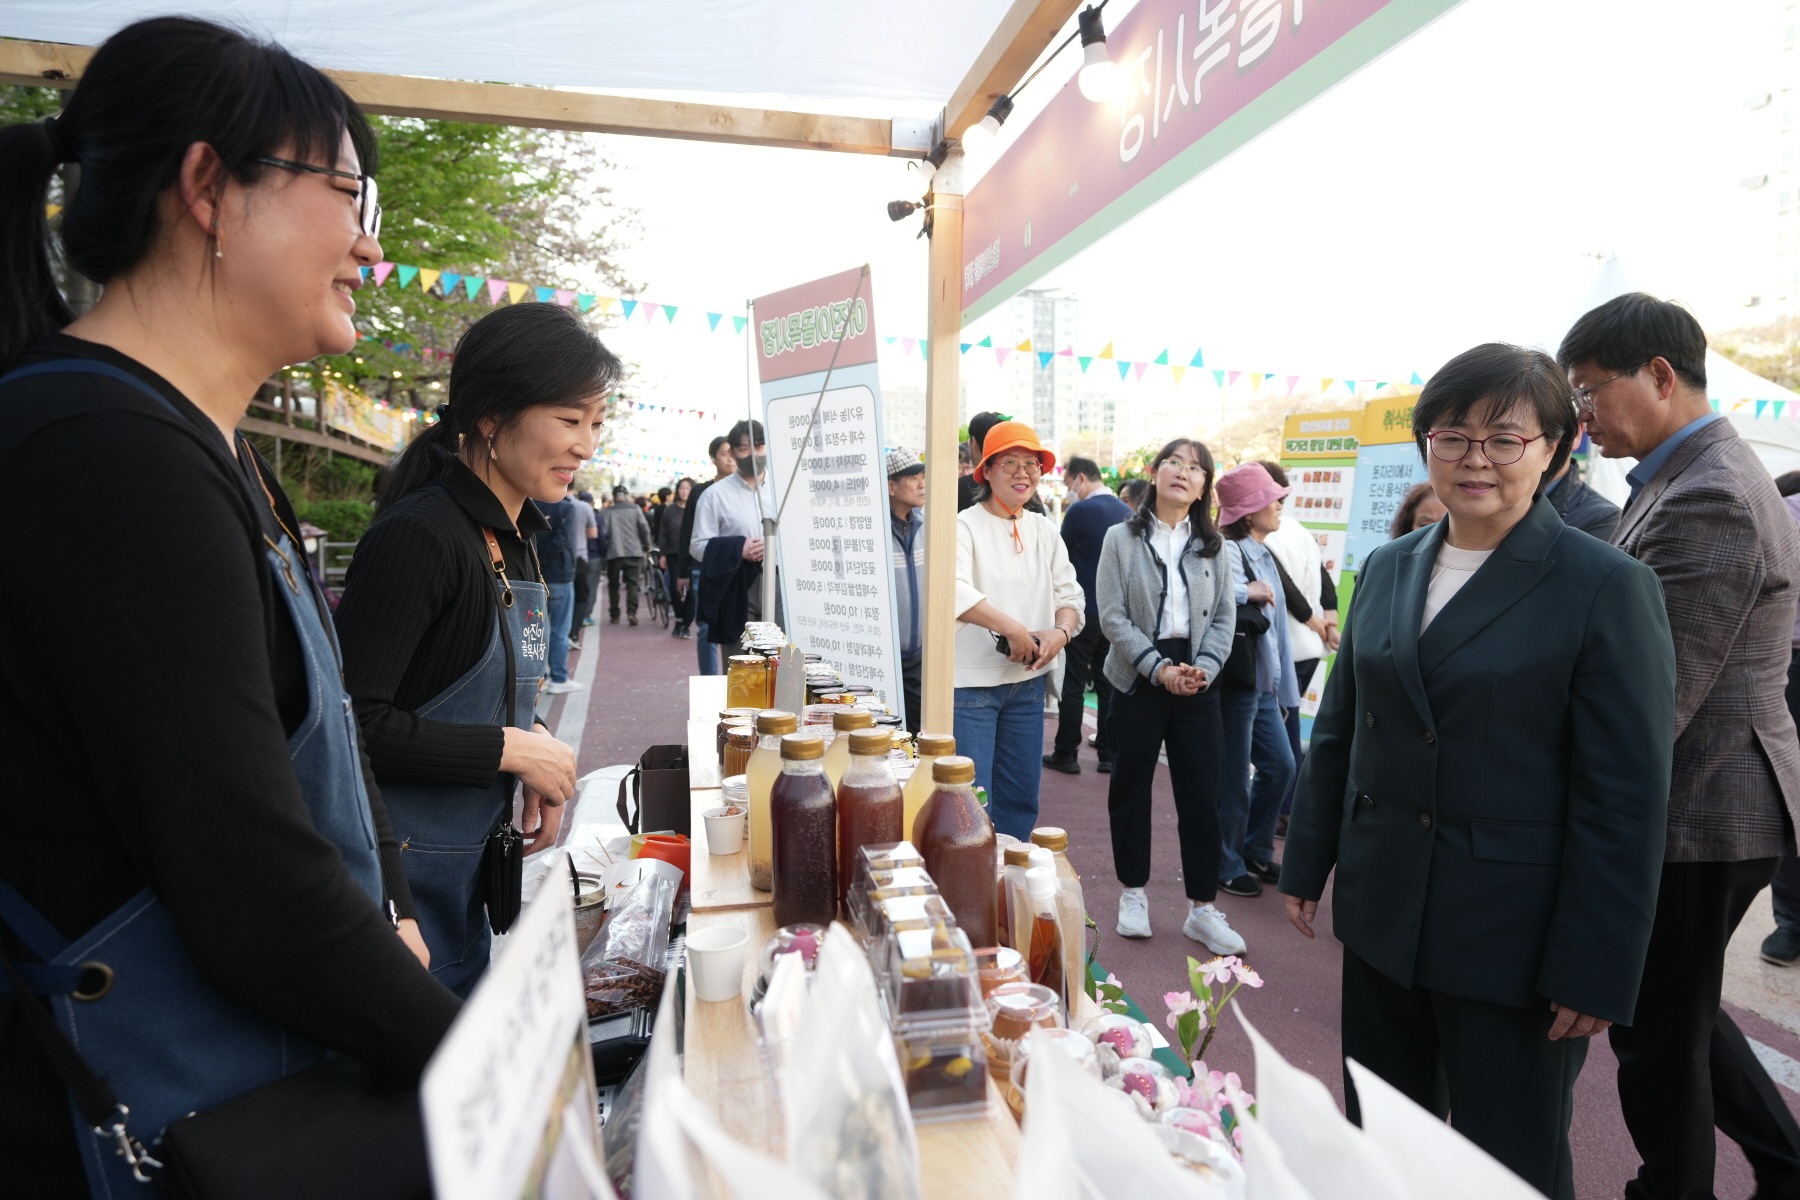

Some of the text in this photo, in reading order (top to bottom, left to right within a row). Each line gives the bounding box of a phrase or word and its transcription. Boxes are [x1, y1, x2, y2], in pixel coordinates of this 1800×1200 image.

[1372, 464, 1413, 480] 돗자리에서
[523, 623, 545, 643] 어진이
[521, 640, 546, 661] 골목시장
